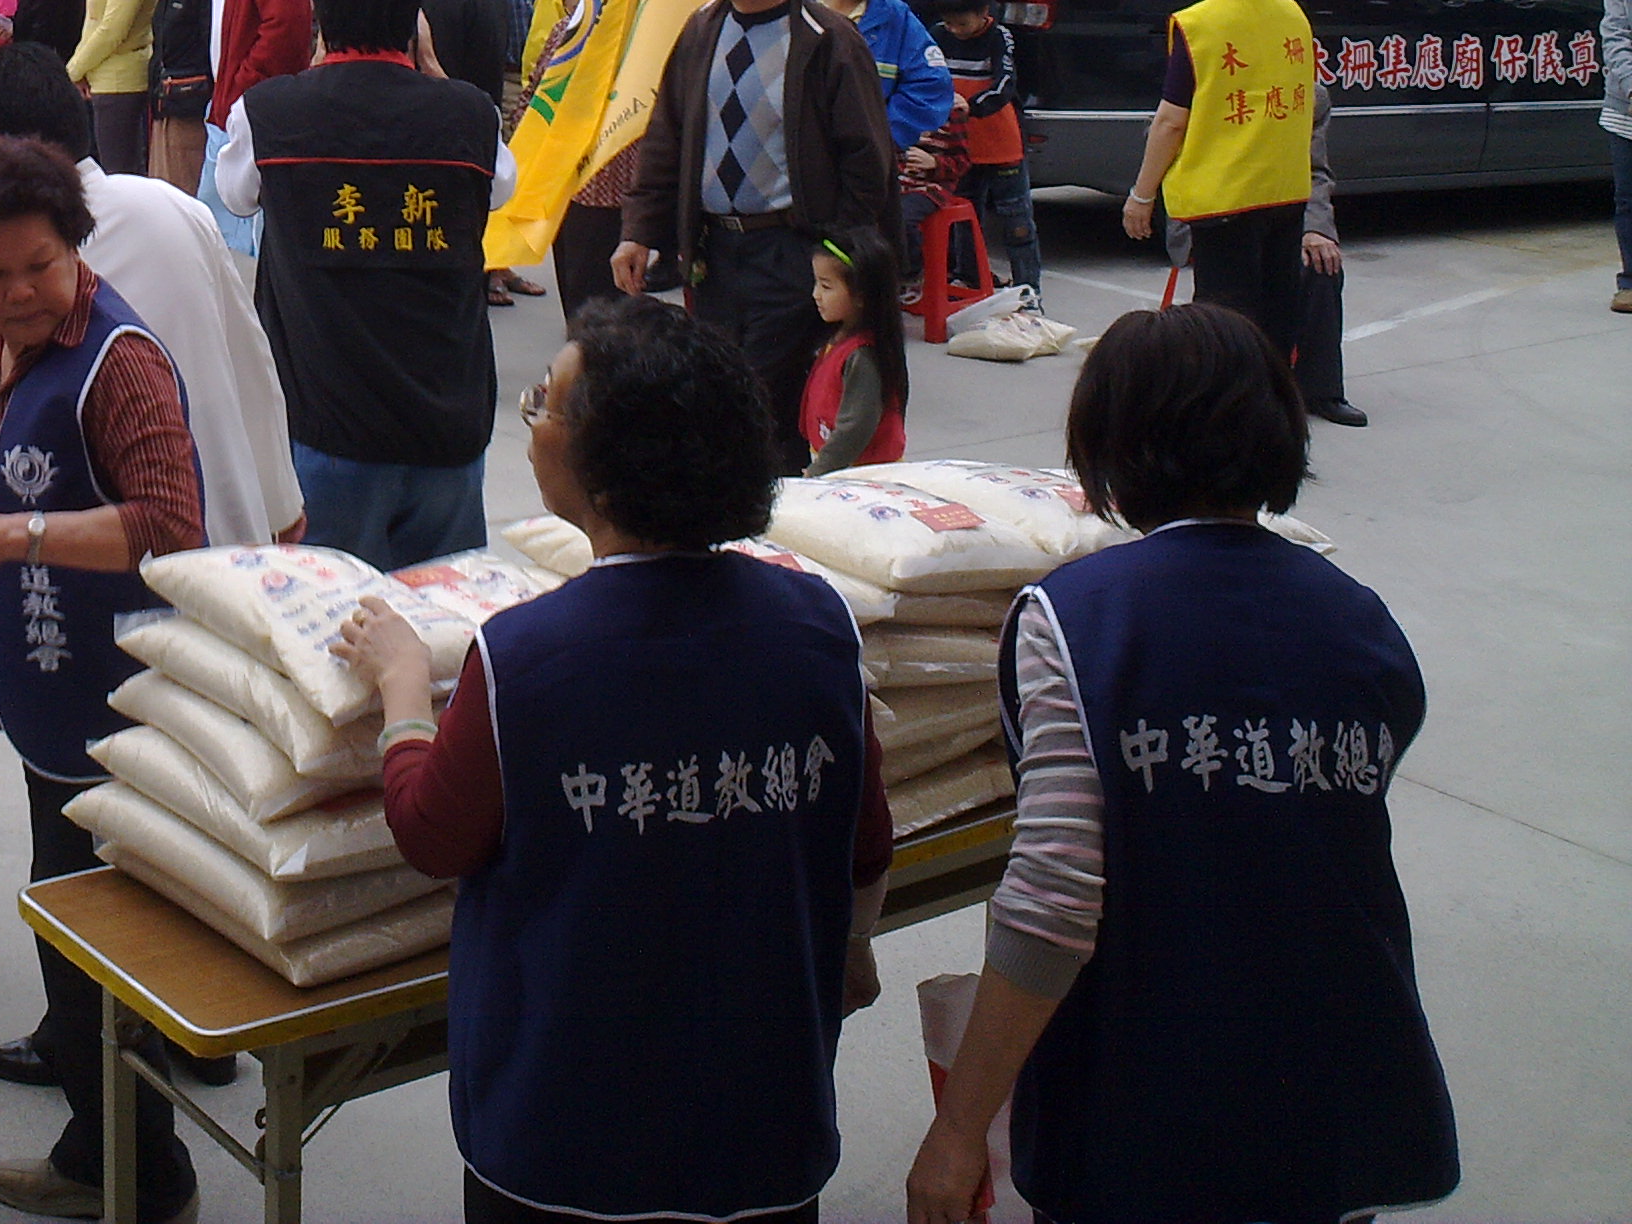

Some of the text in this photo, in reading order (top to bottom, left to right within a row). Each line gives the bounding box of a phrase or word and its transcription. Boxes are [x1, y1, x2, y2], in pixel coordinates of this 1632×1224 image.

[1492, 30, 1606, 86] 保儀尊
[560, 734, 838, 836] 中華道教總會
